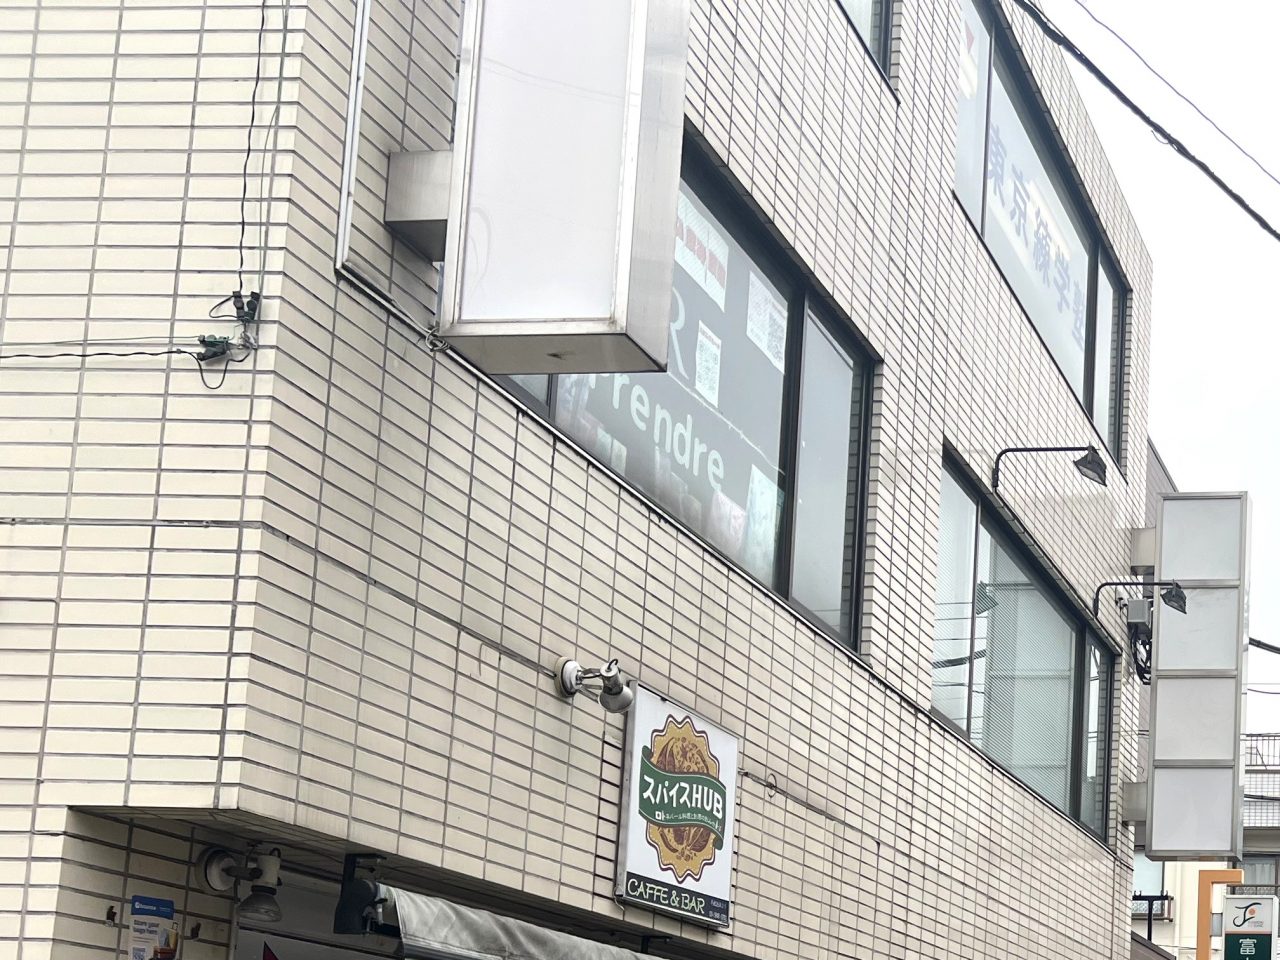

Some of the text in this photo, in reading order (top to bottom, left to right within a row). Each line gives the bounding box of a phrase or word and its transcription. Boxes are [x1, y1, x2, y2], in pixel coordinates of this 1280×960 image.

[642, 774, 724, 820] スパイスHUB
[627, 878, 669, 905] CAFFE
[669, 890, 681, 907] &
[680, 893, 706, 915] BAR
